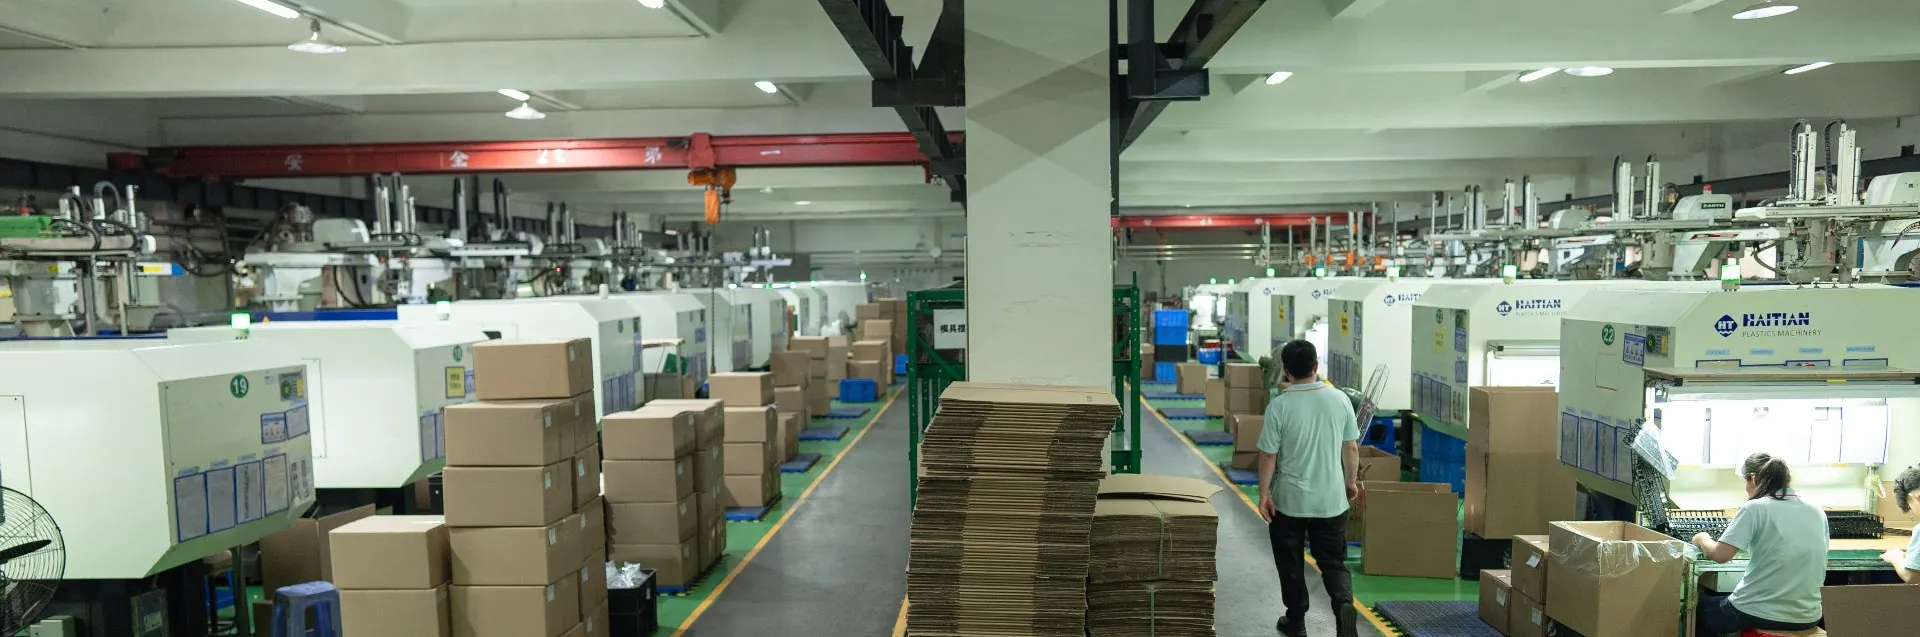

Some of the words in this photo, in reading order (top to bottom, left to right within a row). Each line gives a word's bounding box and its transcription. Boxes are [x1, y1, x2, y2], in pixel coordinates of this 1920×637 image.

[449, 150, 469, 168] 全
[1516, 299, 1561, 309] HAITIAN
[1743, 312, 1809, 327] HAITIAN
[1603, 328, 1614, 342] 22
[1742, 330, 1776, 338] PLASTICS
[1777, 329, 1822, 337] MACHINERY
[232, 378, 247, 395] 19
